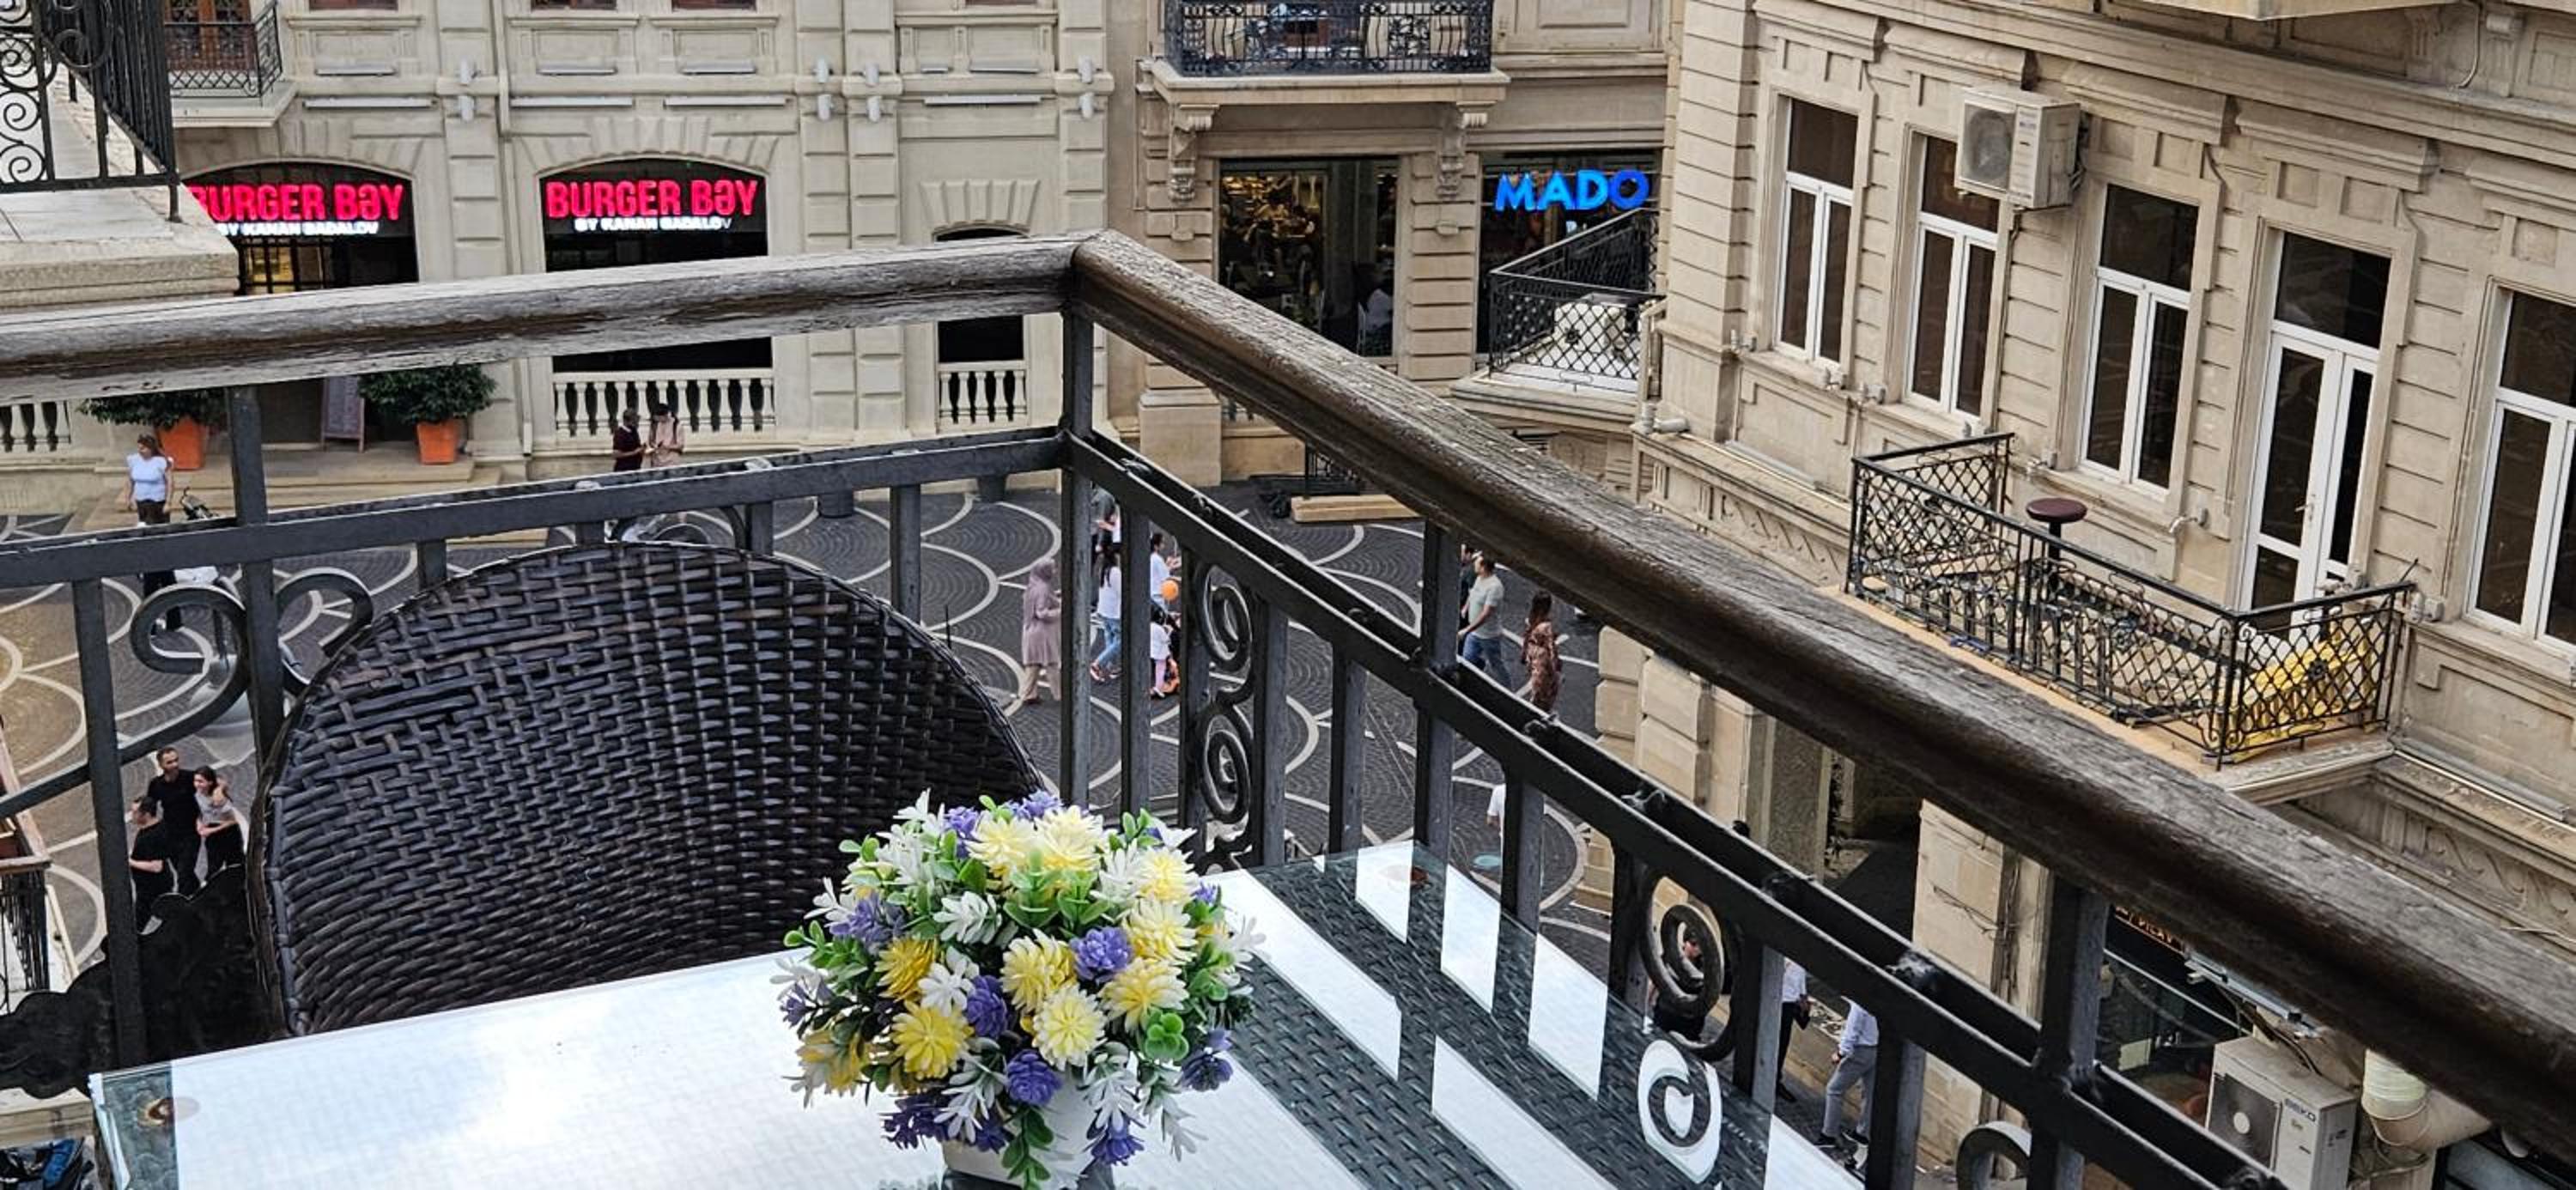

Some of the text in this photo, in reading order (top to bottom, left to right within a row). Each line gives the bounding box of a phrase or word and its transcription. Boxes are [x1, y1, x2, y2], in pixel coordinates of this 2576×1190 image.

[545, 179, 681, 217] BURGER
[1495, 169, 1649, 210] MADO
[574, 218, 598, 232] BY
